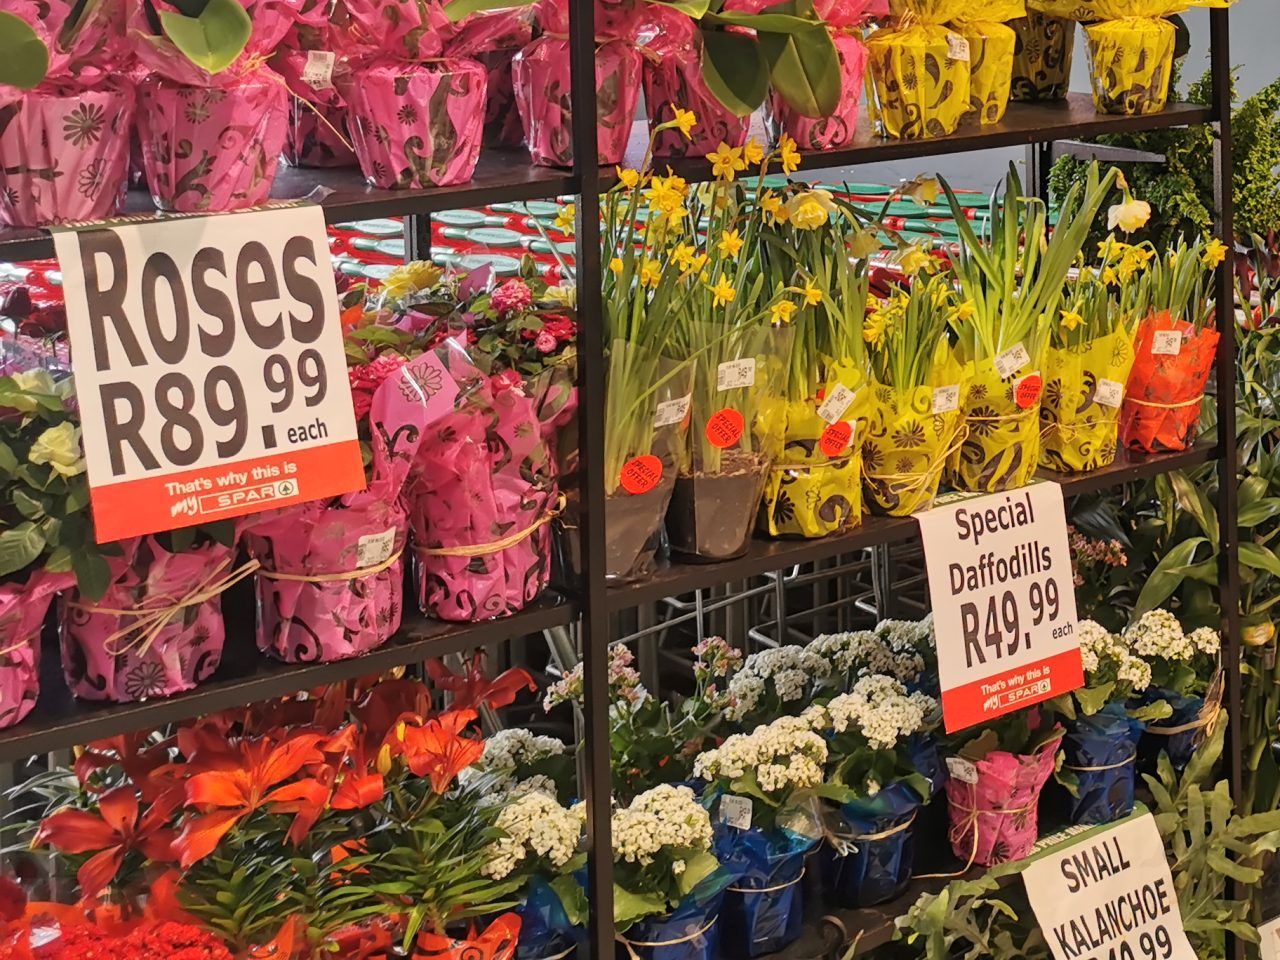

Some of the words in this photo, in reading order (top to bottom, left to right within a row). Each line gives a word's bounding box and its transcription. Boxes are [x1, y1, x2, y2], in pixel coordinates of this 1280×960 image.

[77, 229, 326, 372] Roses
[287, 417, 329, 444] each
[711, 423, 732, 444] OFFER
[716, 414, 740, 439] SPECIAL
[165, 477, 213, 496] That's
[216, 470, 248, 490] why
[252, 463, 282, 481] this
[284, 461, 297, 475] is
[626, 469, 649, 488] OFFER
[631, 459, 659, 482] SPECIAL
[170, 497, 199, 518] my
[218, 486, 277, 508] SPAR
[955, 491, 1035, 545] Special
[949, 540, 1052, 595] Daffodills
[1052, 621, 1074, 640] each
[981, 680, 1007, 696] That's
[1007, 673, 1025, 690] why
[1026, 667, 1042, 682] this
[1042, 665, 1051, 675] is
[1008, 685, 1039, 702] SPAR
[1038, 831, 1070, 848] PRICE
[1060, 836, 1131, 894] SMALL
[1053, 877, 1171, 960] KALANCHOE
